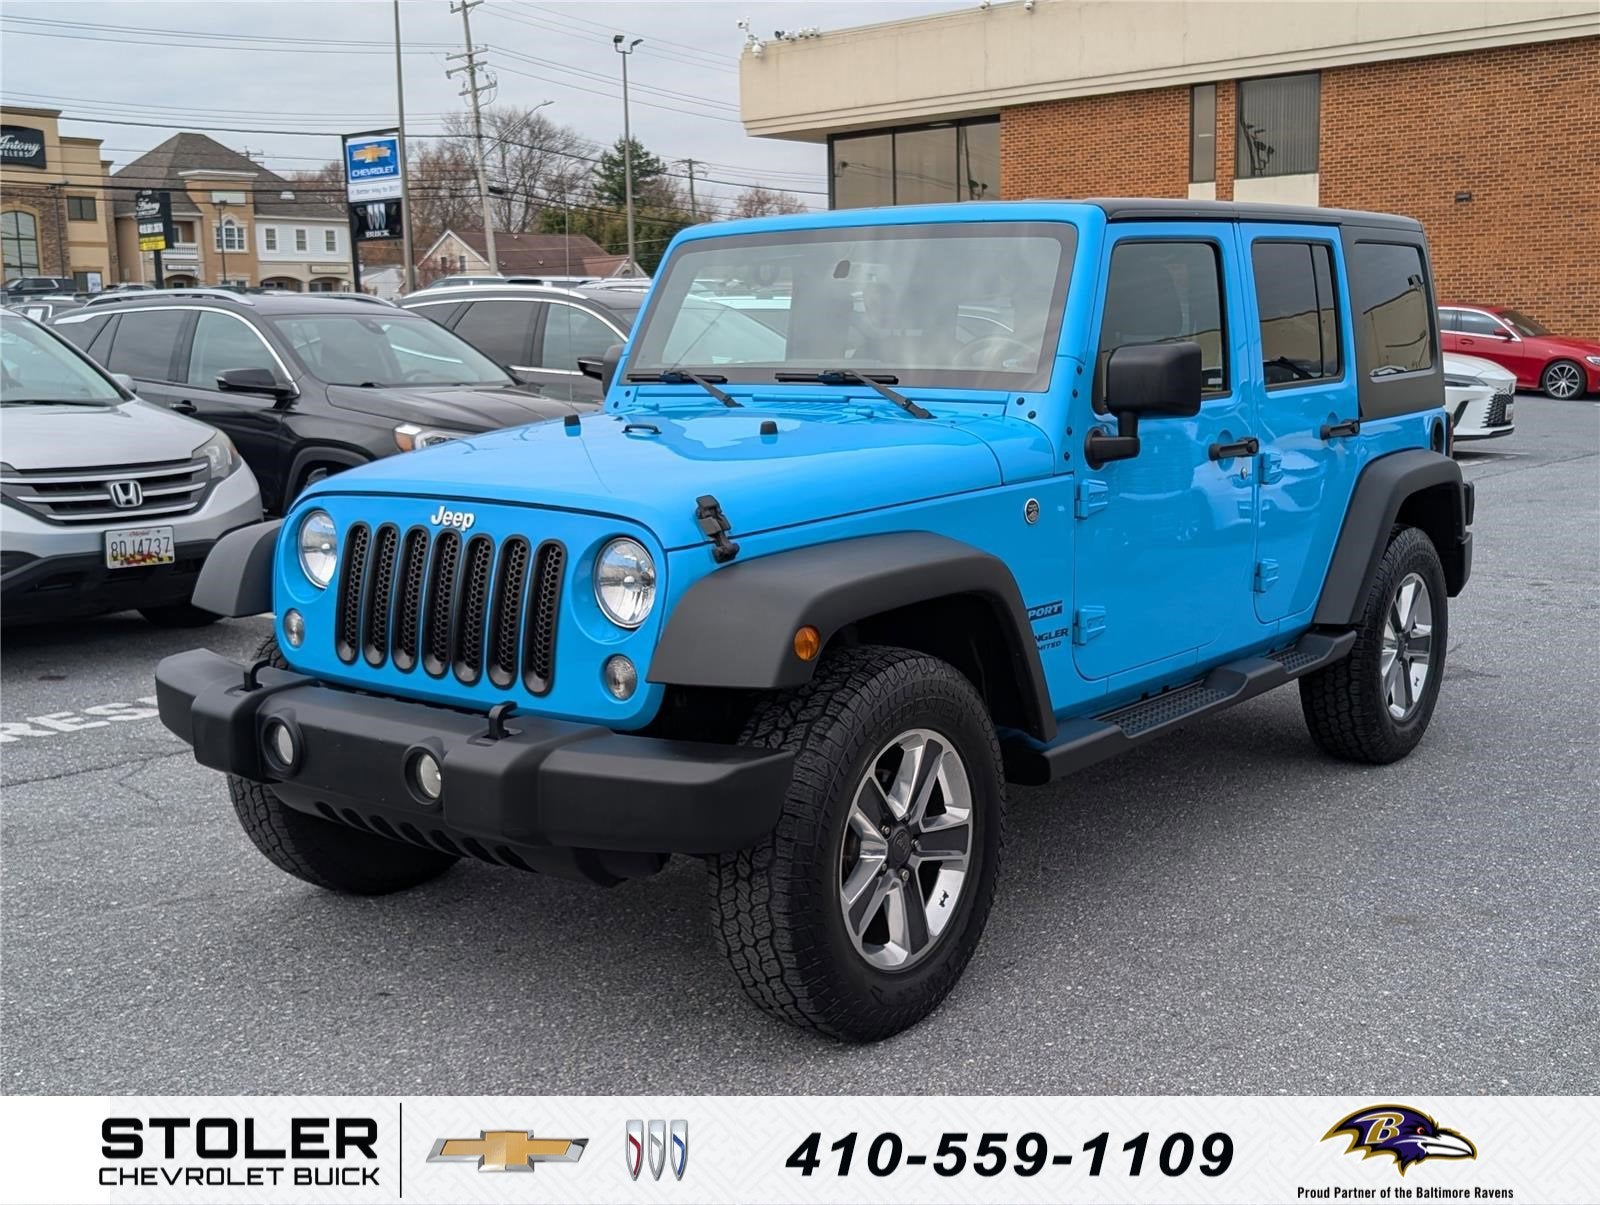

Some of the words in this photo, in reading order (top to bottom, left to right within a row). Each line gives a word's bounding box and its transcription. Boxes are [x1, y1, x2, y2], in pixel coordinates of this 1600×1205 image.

[351, 165, 395, 177] CHEVROLET
[364, 229, 390, 238] BUICK
[431, 505, 475, 532] Jeep
[1027, 604, 1061, 619] PORT
[1035, 628, 1068, 642] NGLER
[0, 696, 159, 743] RES
